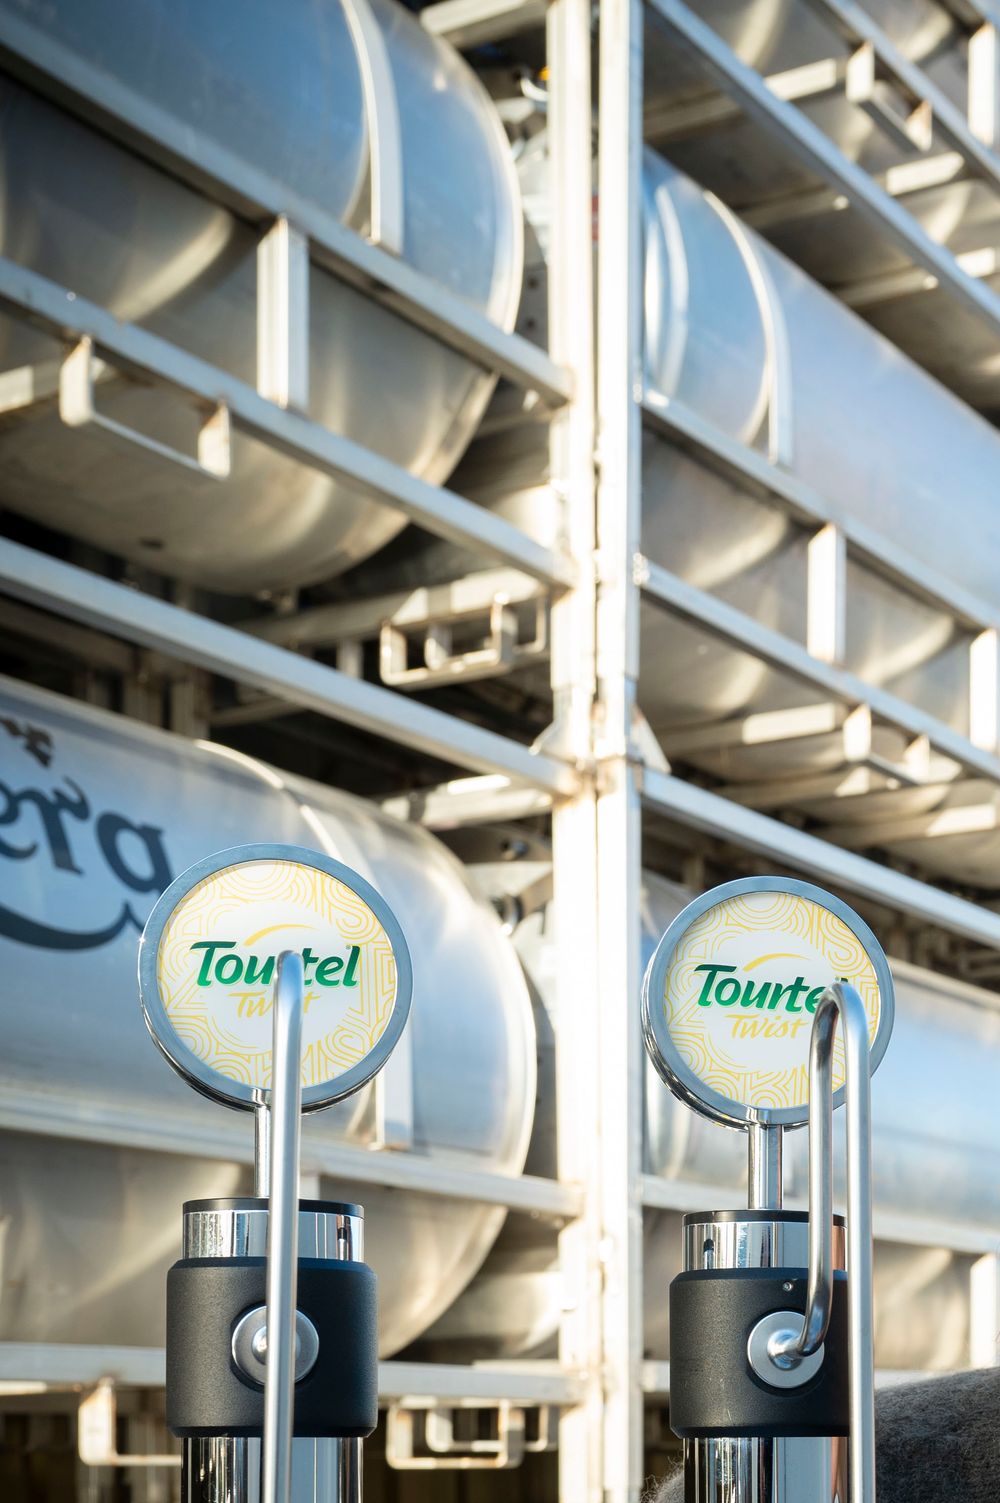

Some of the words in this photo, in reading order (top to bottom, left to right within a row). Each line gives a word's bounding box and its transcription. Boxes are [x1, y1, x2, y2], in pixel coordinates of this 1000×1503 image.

[190, 941, 361, 986] Toutel
[227, 991, 321, 1018] Twt
[694, 964, 849, 1014] Tourte
[724, 1013, 810, 1040] Twist
